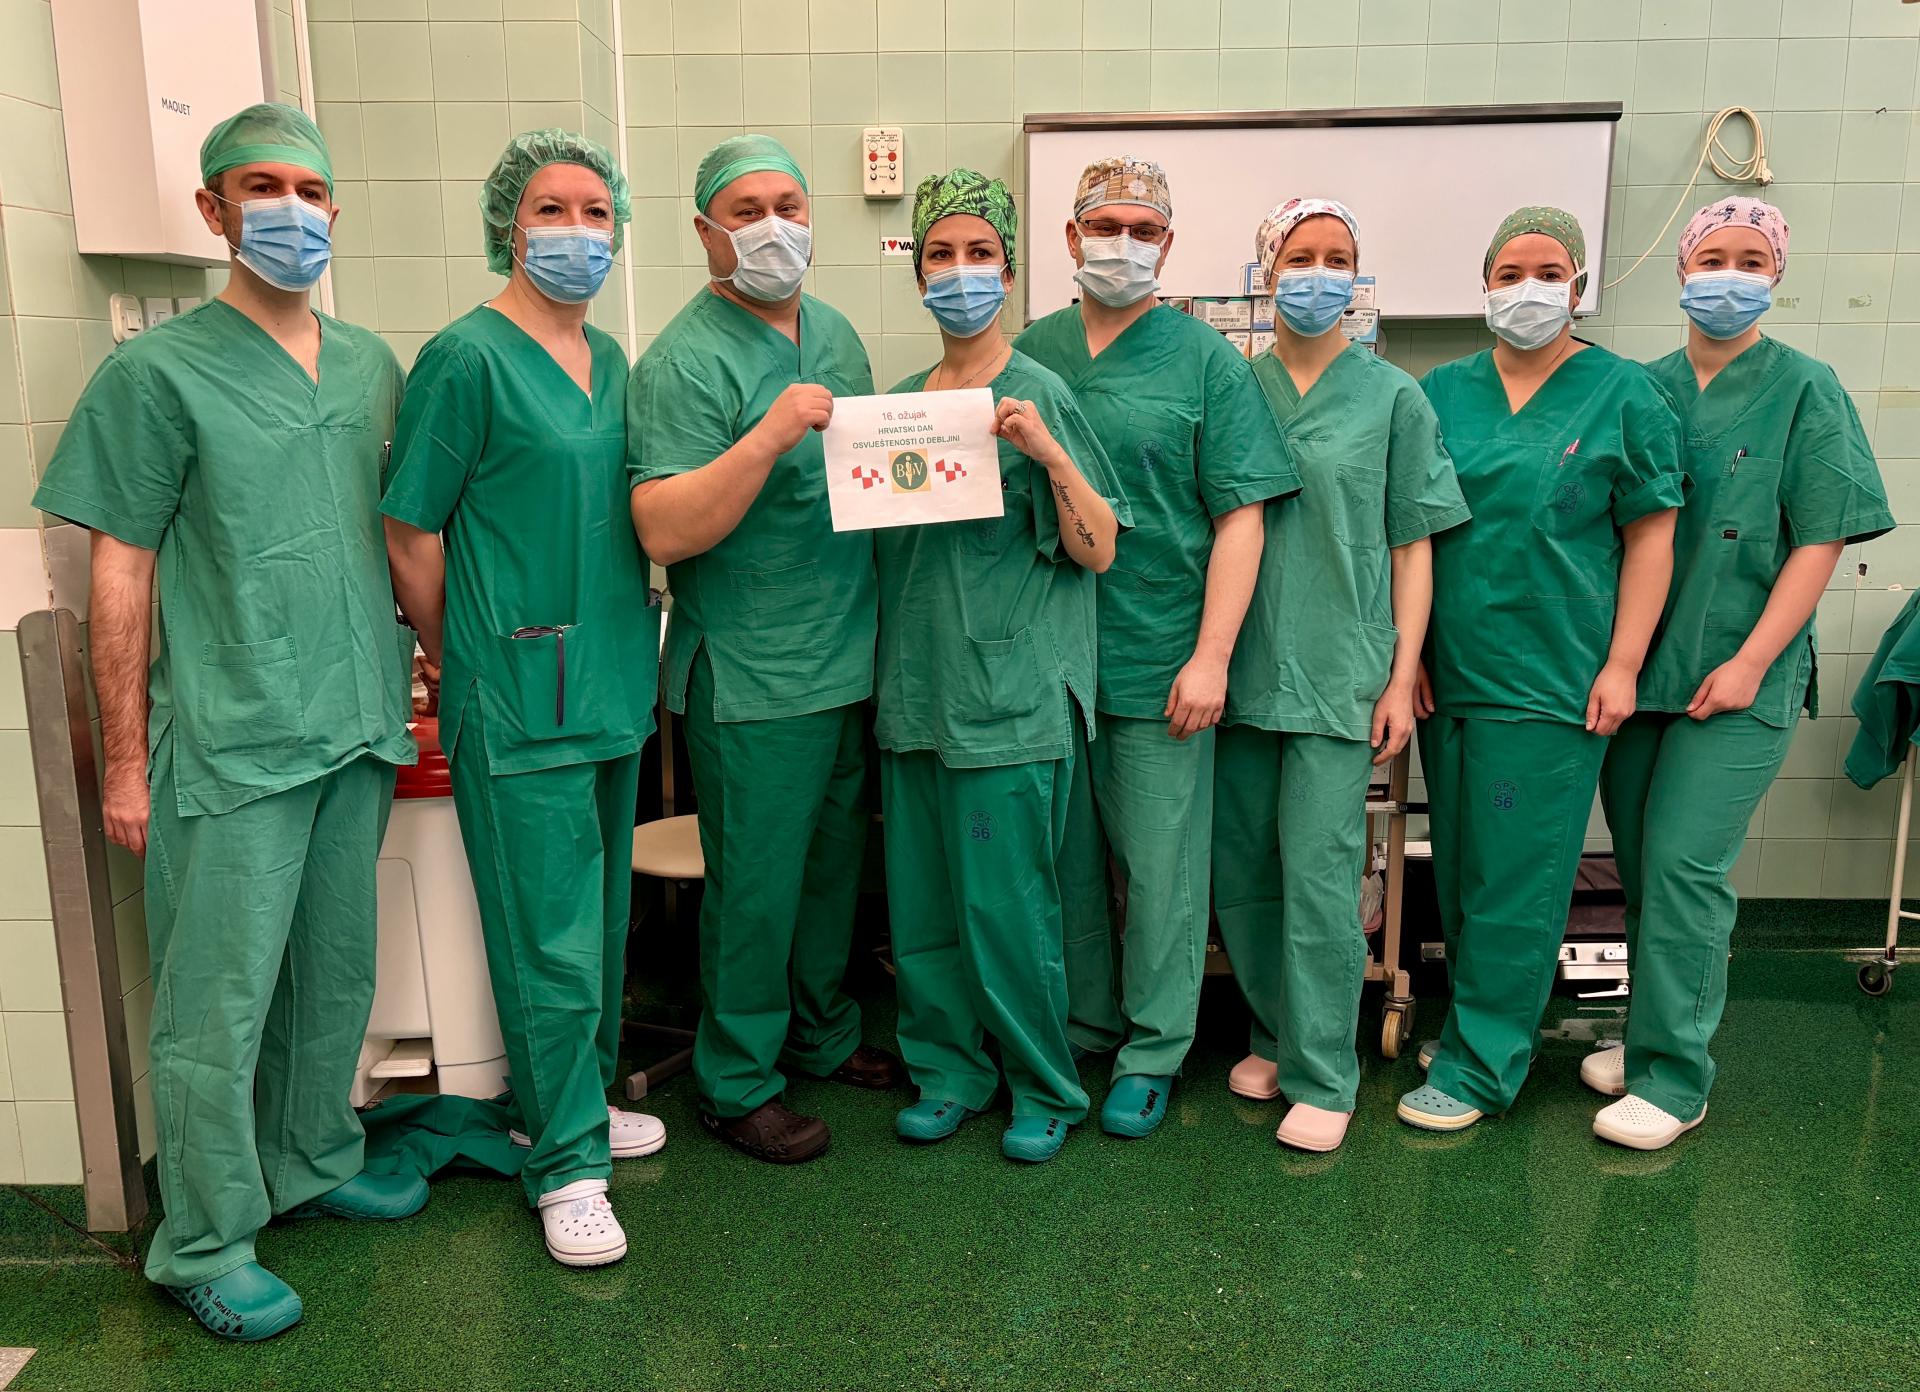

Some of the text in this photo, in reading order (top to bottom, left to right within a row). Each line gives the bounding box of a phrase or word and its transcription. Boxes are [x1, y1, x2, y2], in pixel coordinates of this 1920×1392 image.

[161, 97, 190, 116] MAQUET
[882, 410, 928, 421] 16. ožujak
[878, 424, 934, 435] HRVATSKI DAN
[852, 435, 961, 450] OSVIJEŠTENOSTI O DEBLJINI
[1494, 795, 1513, 808] 56
[971, 826, 991, 840] 56
